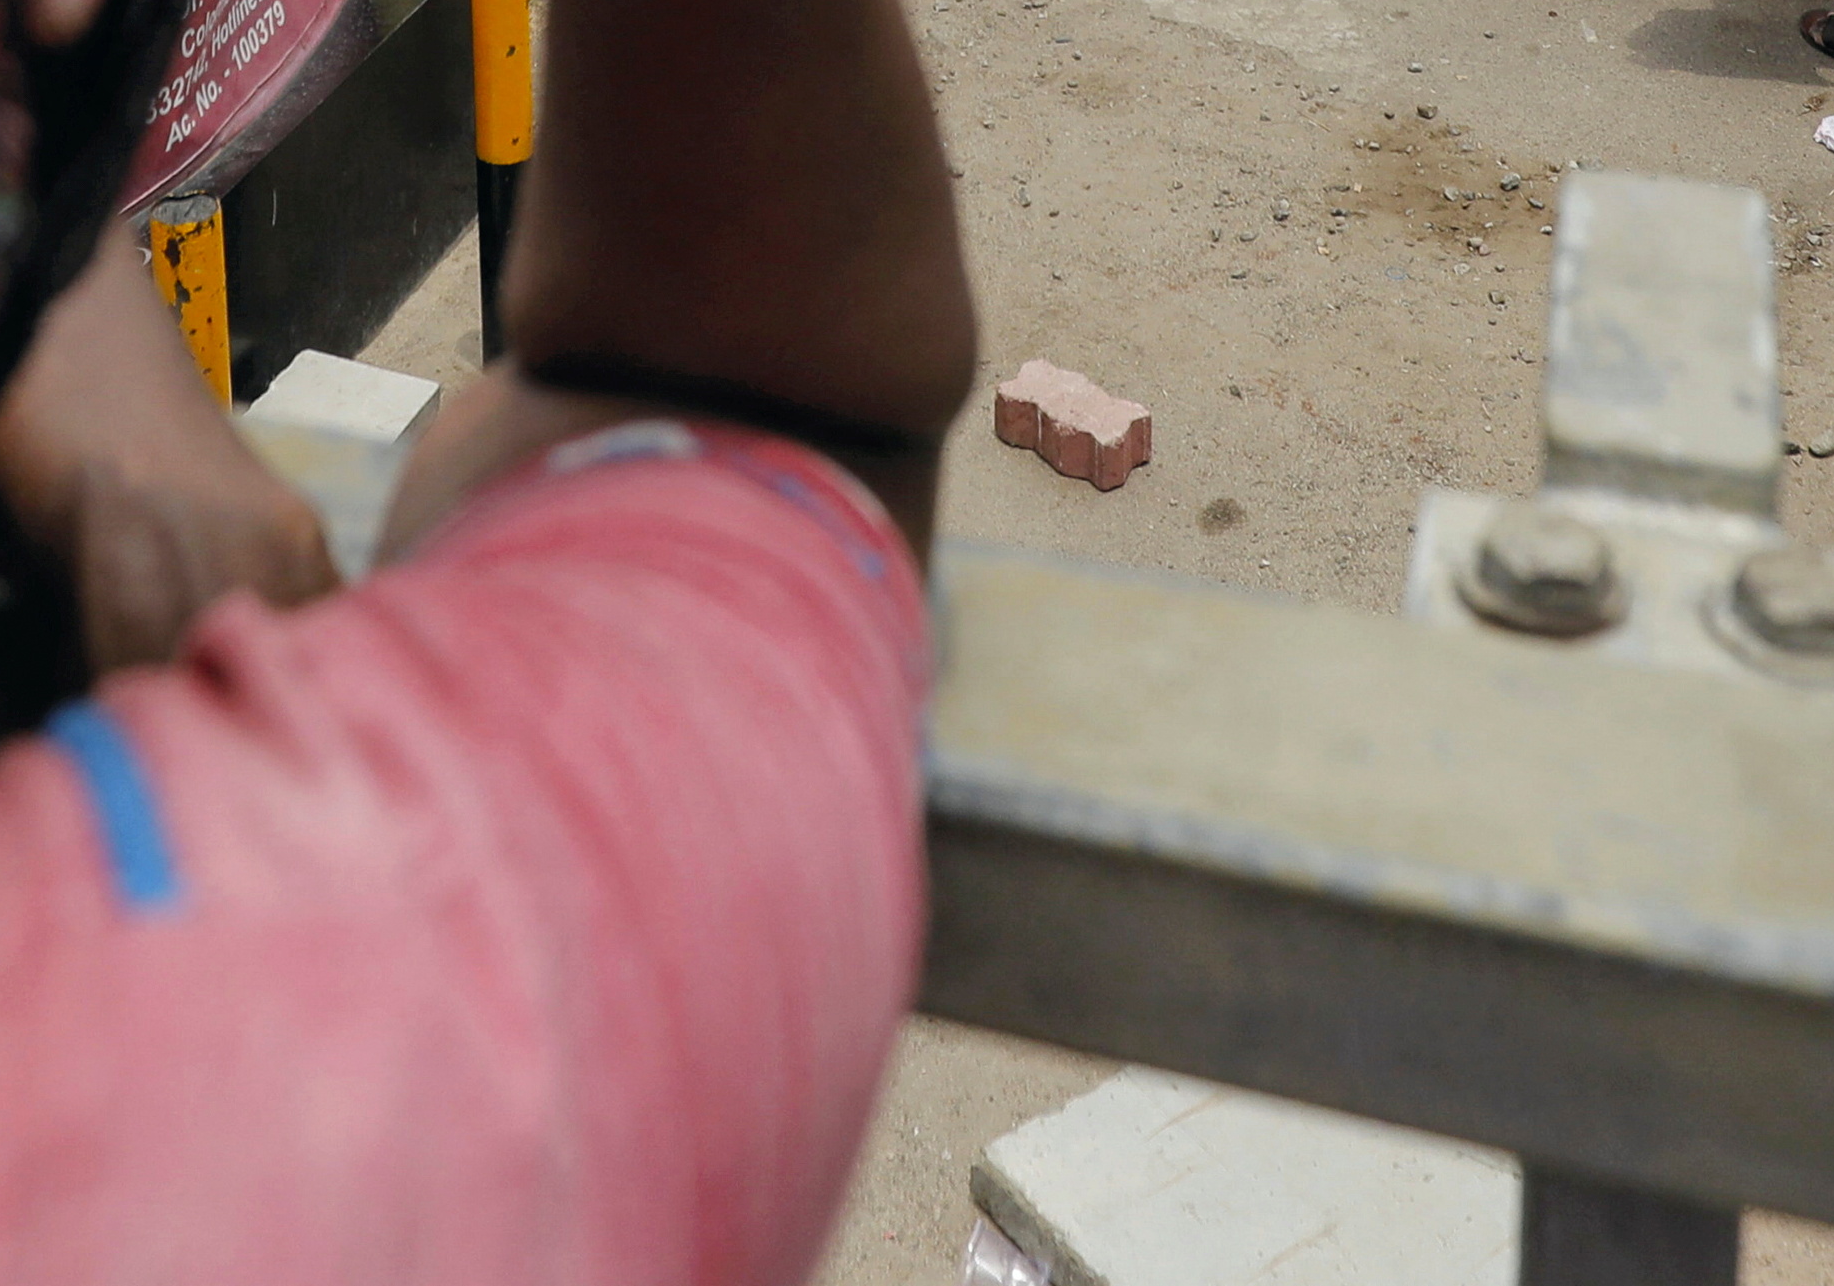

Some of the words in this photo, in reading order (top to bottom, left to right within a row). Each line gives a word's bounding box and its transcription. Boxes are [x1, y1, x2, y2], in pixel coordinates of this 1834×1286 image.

[165, 109, 197, 154] Ac.
[195, 80, 224, 119] No.
[230, 0, 286, 74] 100379
